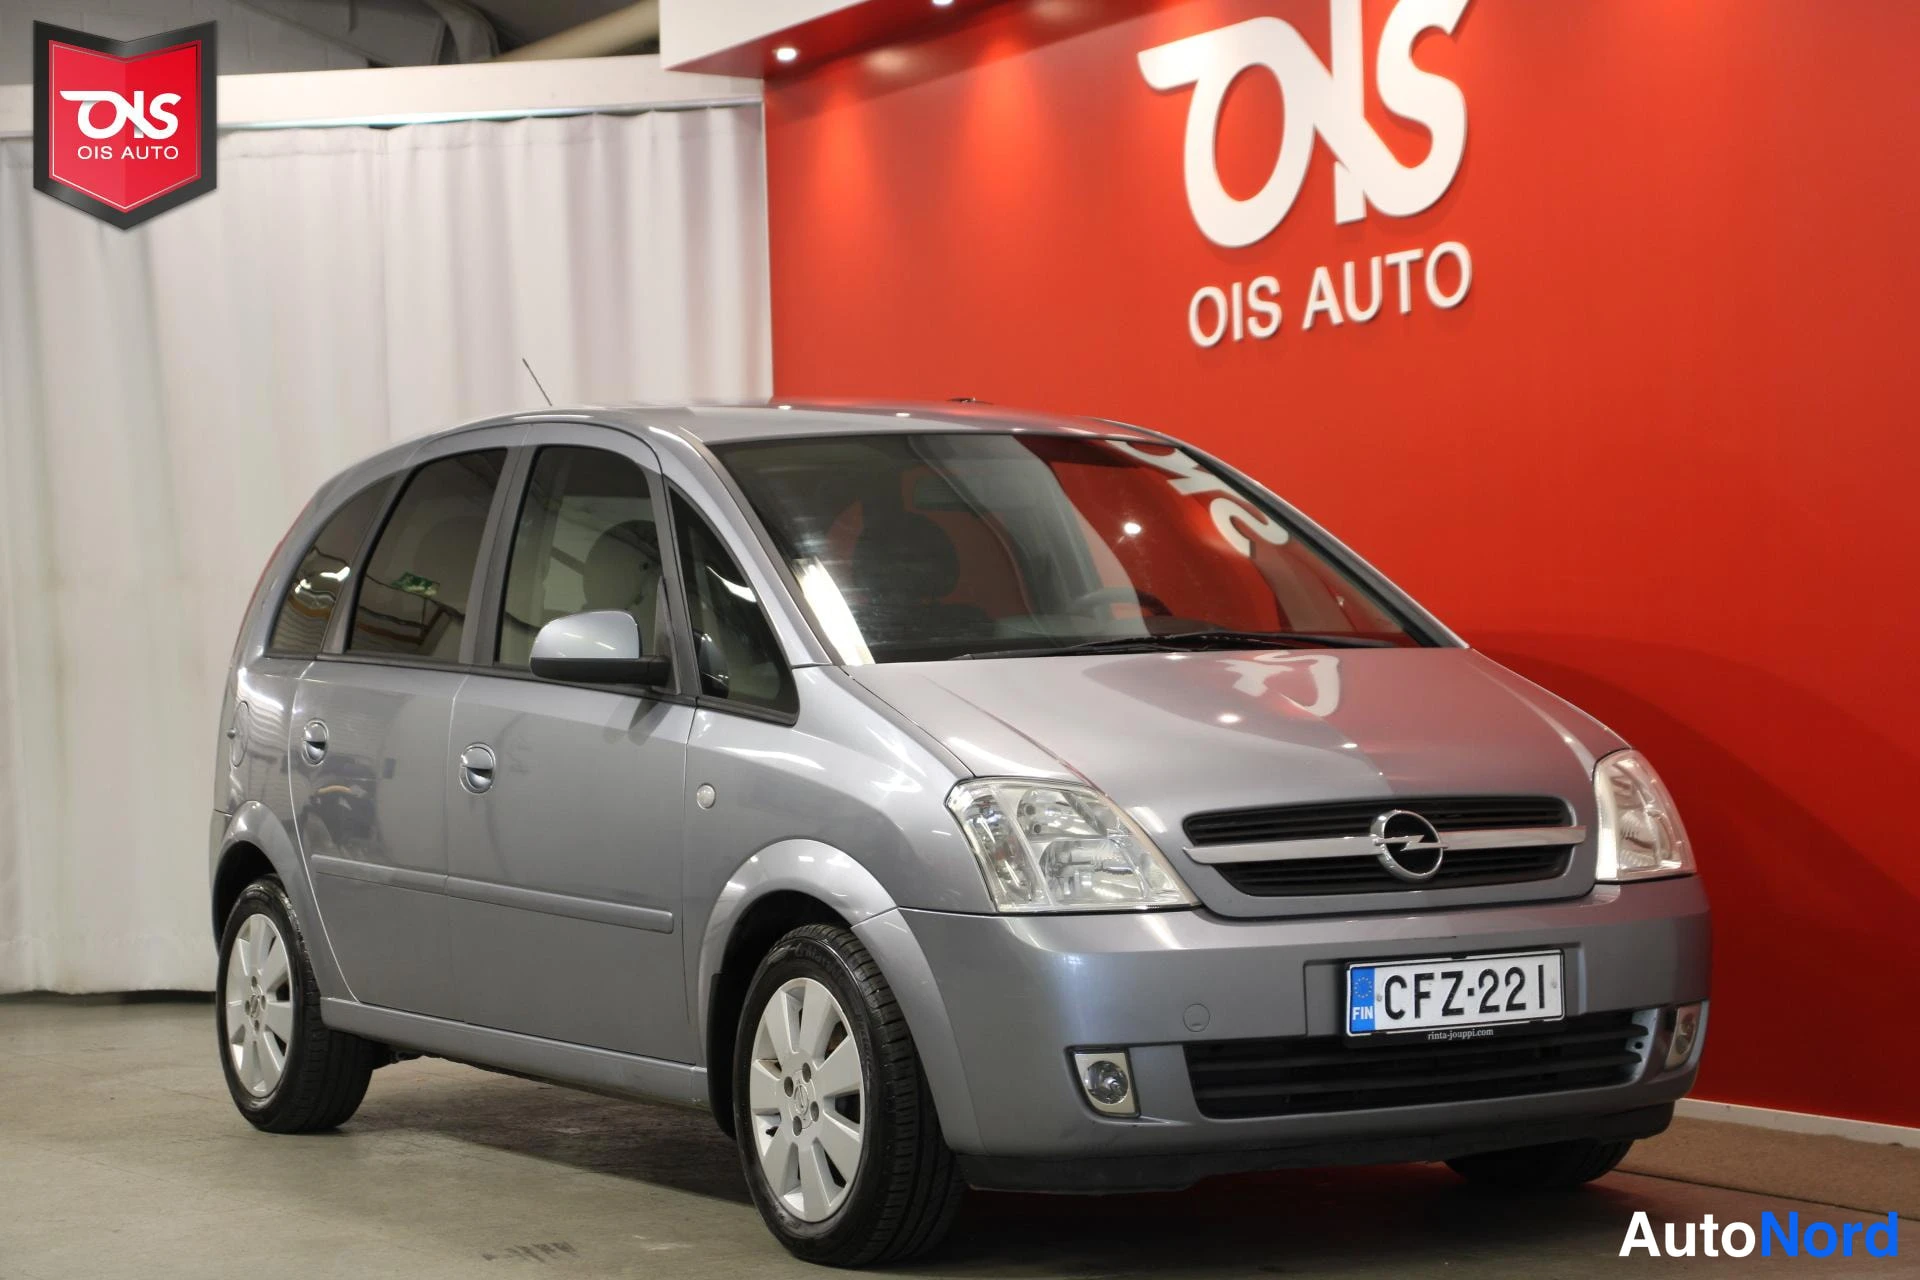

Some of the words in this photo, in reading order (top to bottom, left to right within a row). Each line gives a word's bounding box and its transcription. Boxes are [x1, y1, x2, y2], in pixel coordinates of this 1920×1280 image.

[1137, 0, 1471, 248] OIS
[1188, 276, 1282, 348] OIS
[1302, 241, 1473, 331] AUTO
[1352, 1005, 1374, 1021] FIN
[1384, 964, 1546, 1021] CFZ-221
[1427, 1027, 1495, 1041] rinta-jouppi.com
